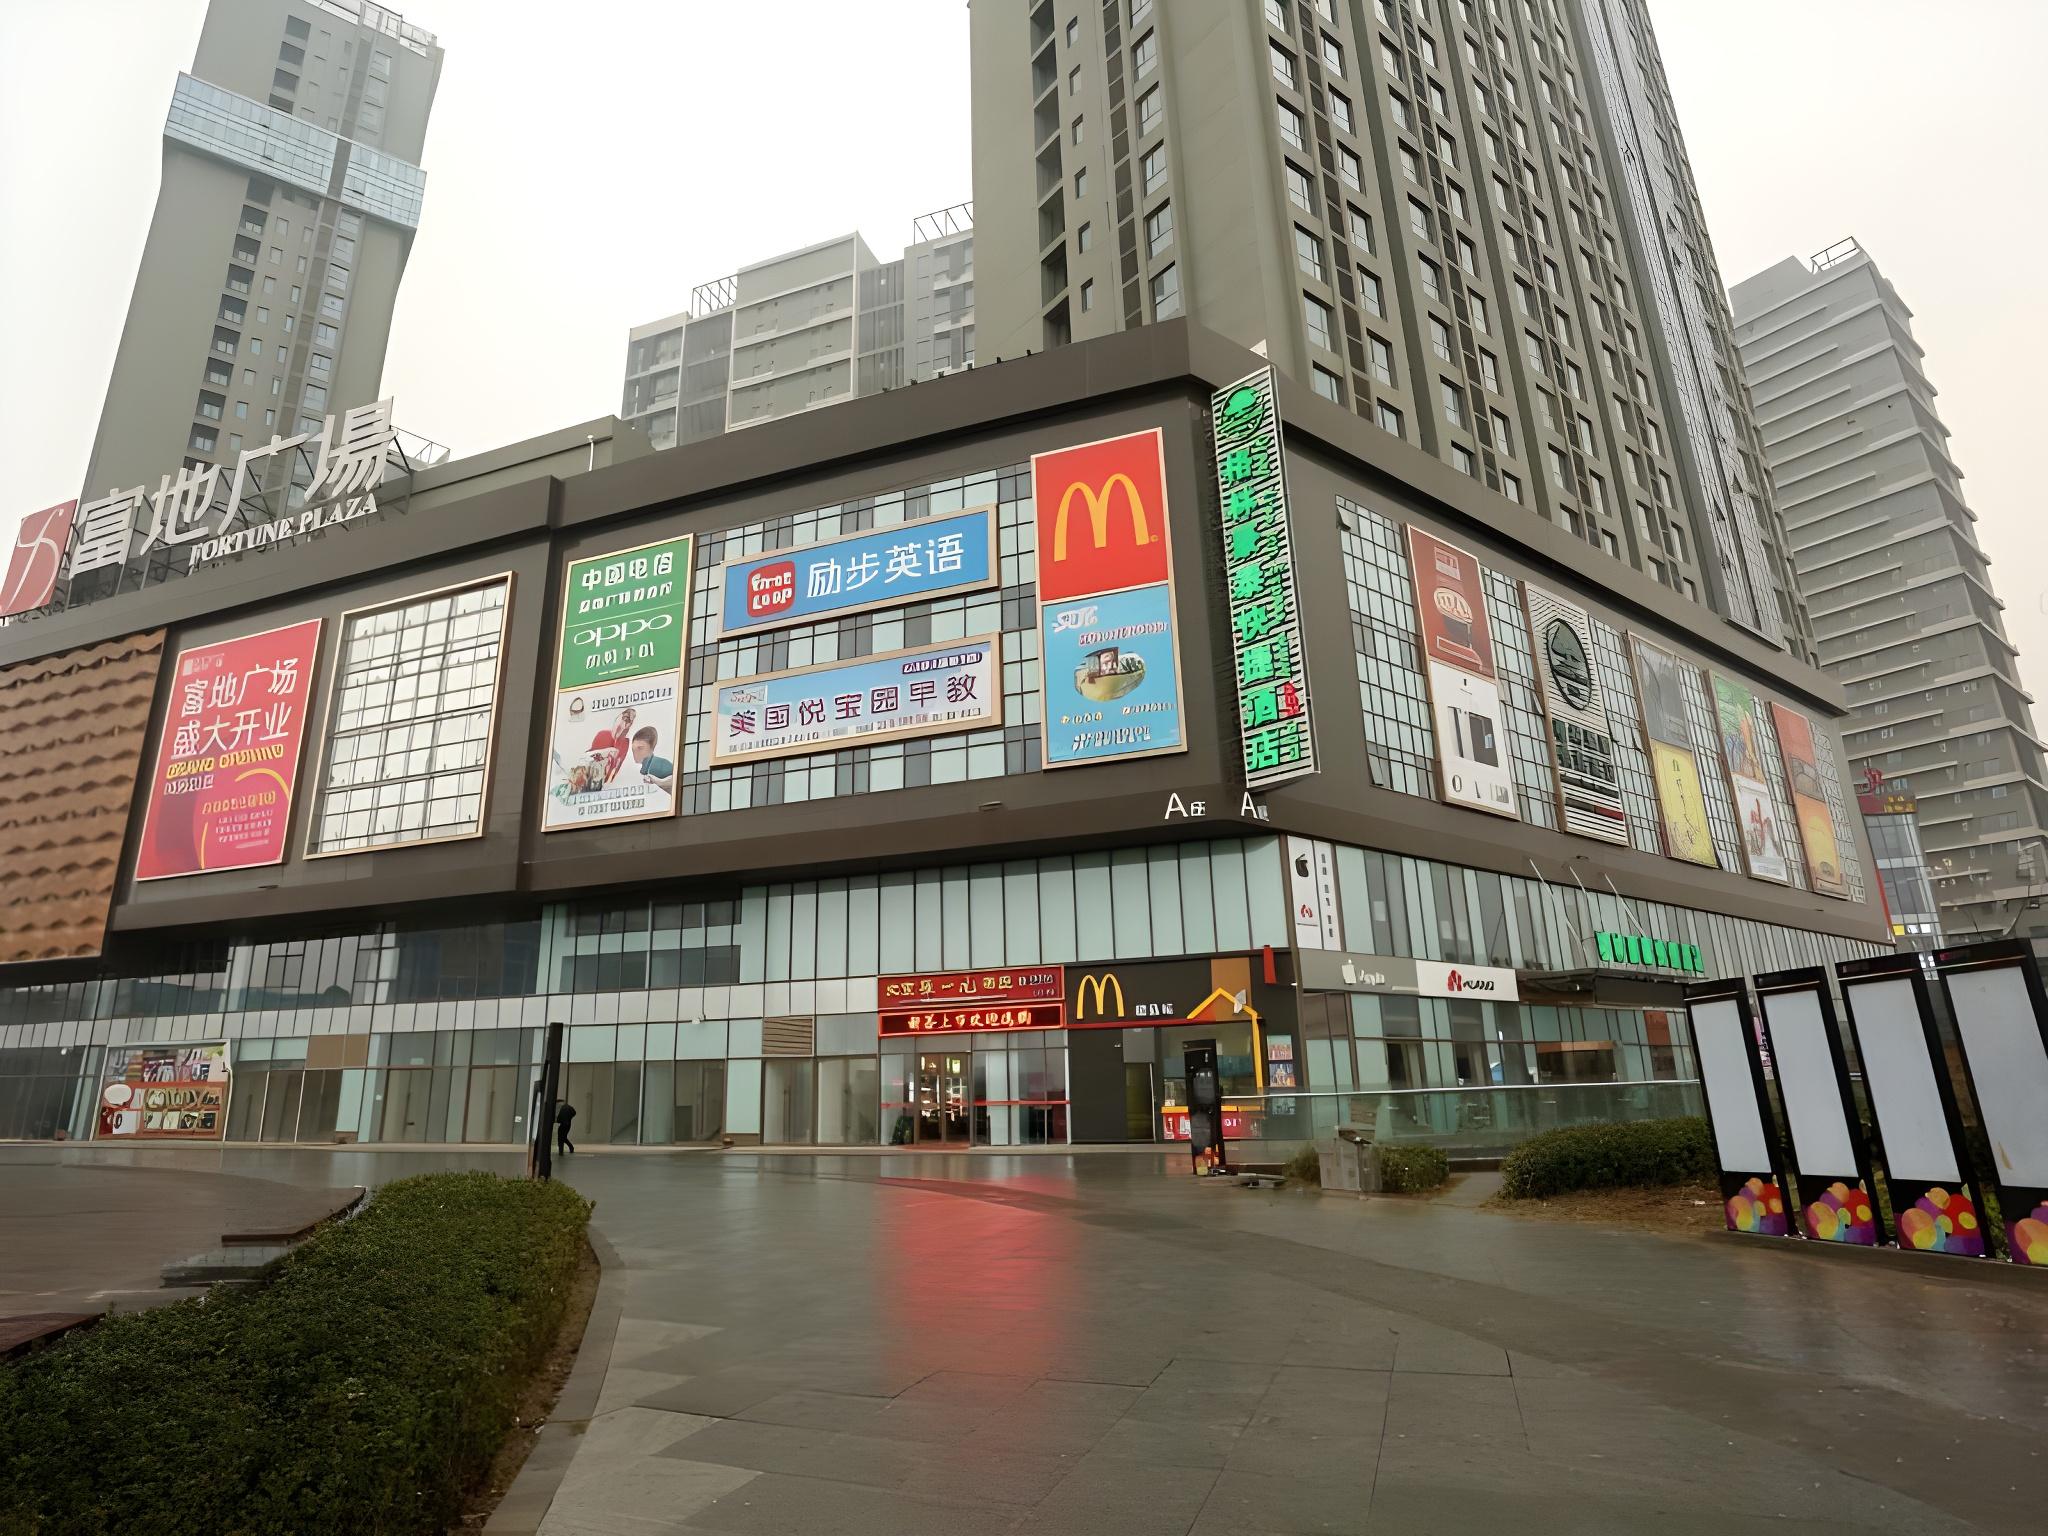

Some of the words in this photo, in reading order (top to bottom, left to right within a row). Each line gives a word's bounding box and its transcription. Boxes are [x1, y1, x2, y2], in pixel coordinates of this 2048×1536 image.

[297, 493, 378, 535] PLAZA
[807, 532, 965, 599] 励步英语
[181, 657, 299, 718] 富地广场
[729, 674, 978, 738] 美国悦宝园早教
[171, 701, 292, 760] 盛大开业
